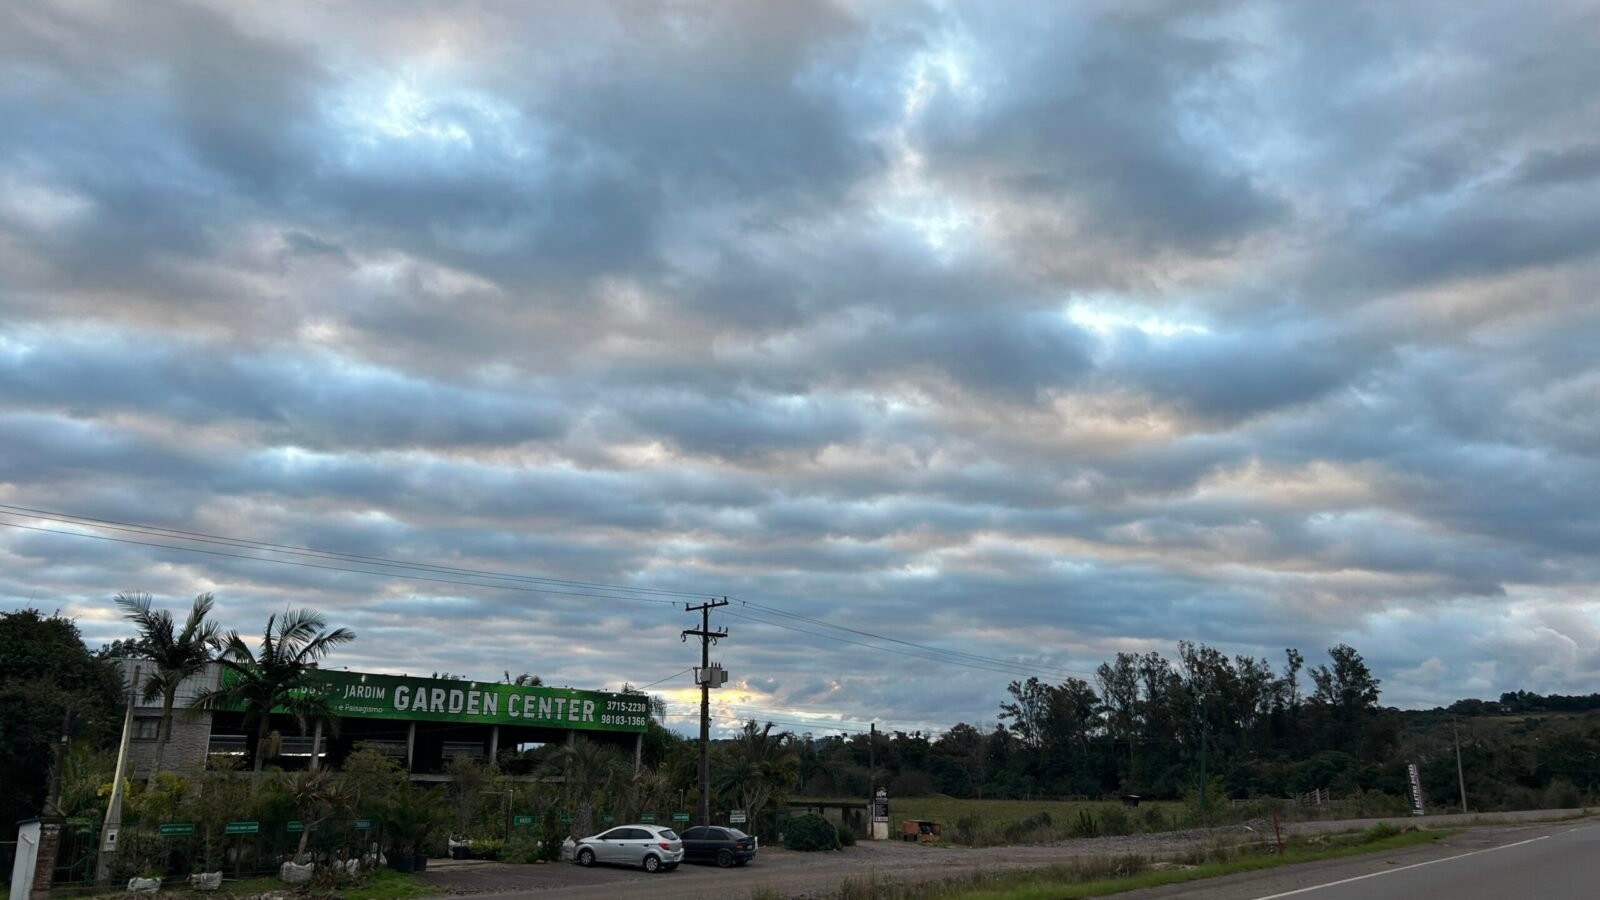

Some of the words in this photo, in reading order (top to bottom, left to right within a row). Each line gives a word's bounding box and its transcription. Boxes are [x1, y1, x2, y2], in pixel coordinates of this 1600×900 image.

[343, 683, 386, 699] JARDIM
[345, 703, 384, 714] Paisagismo
[394, 686, 498, 716] GARDEN
[507, 694, 594, 723] CENTER
[606, 700, 646, 713] 3715-2238
[601, 714, 646, 727] 98183-1366
